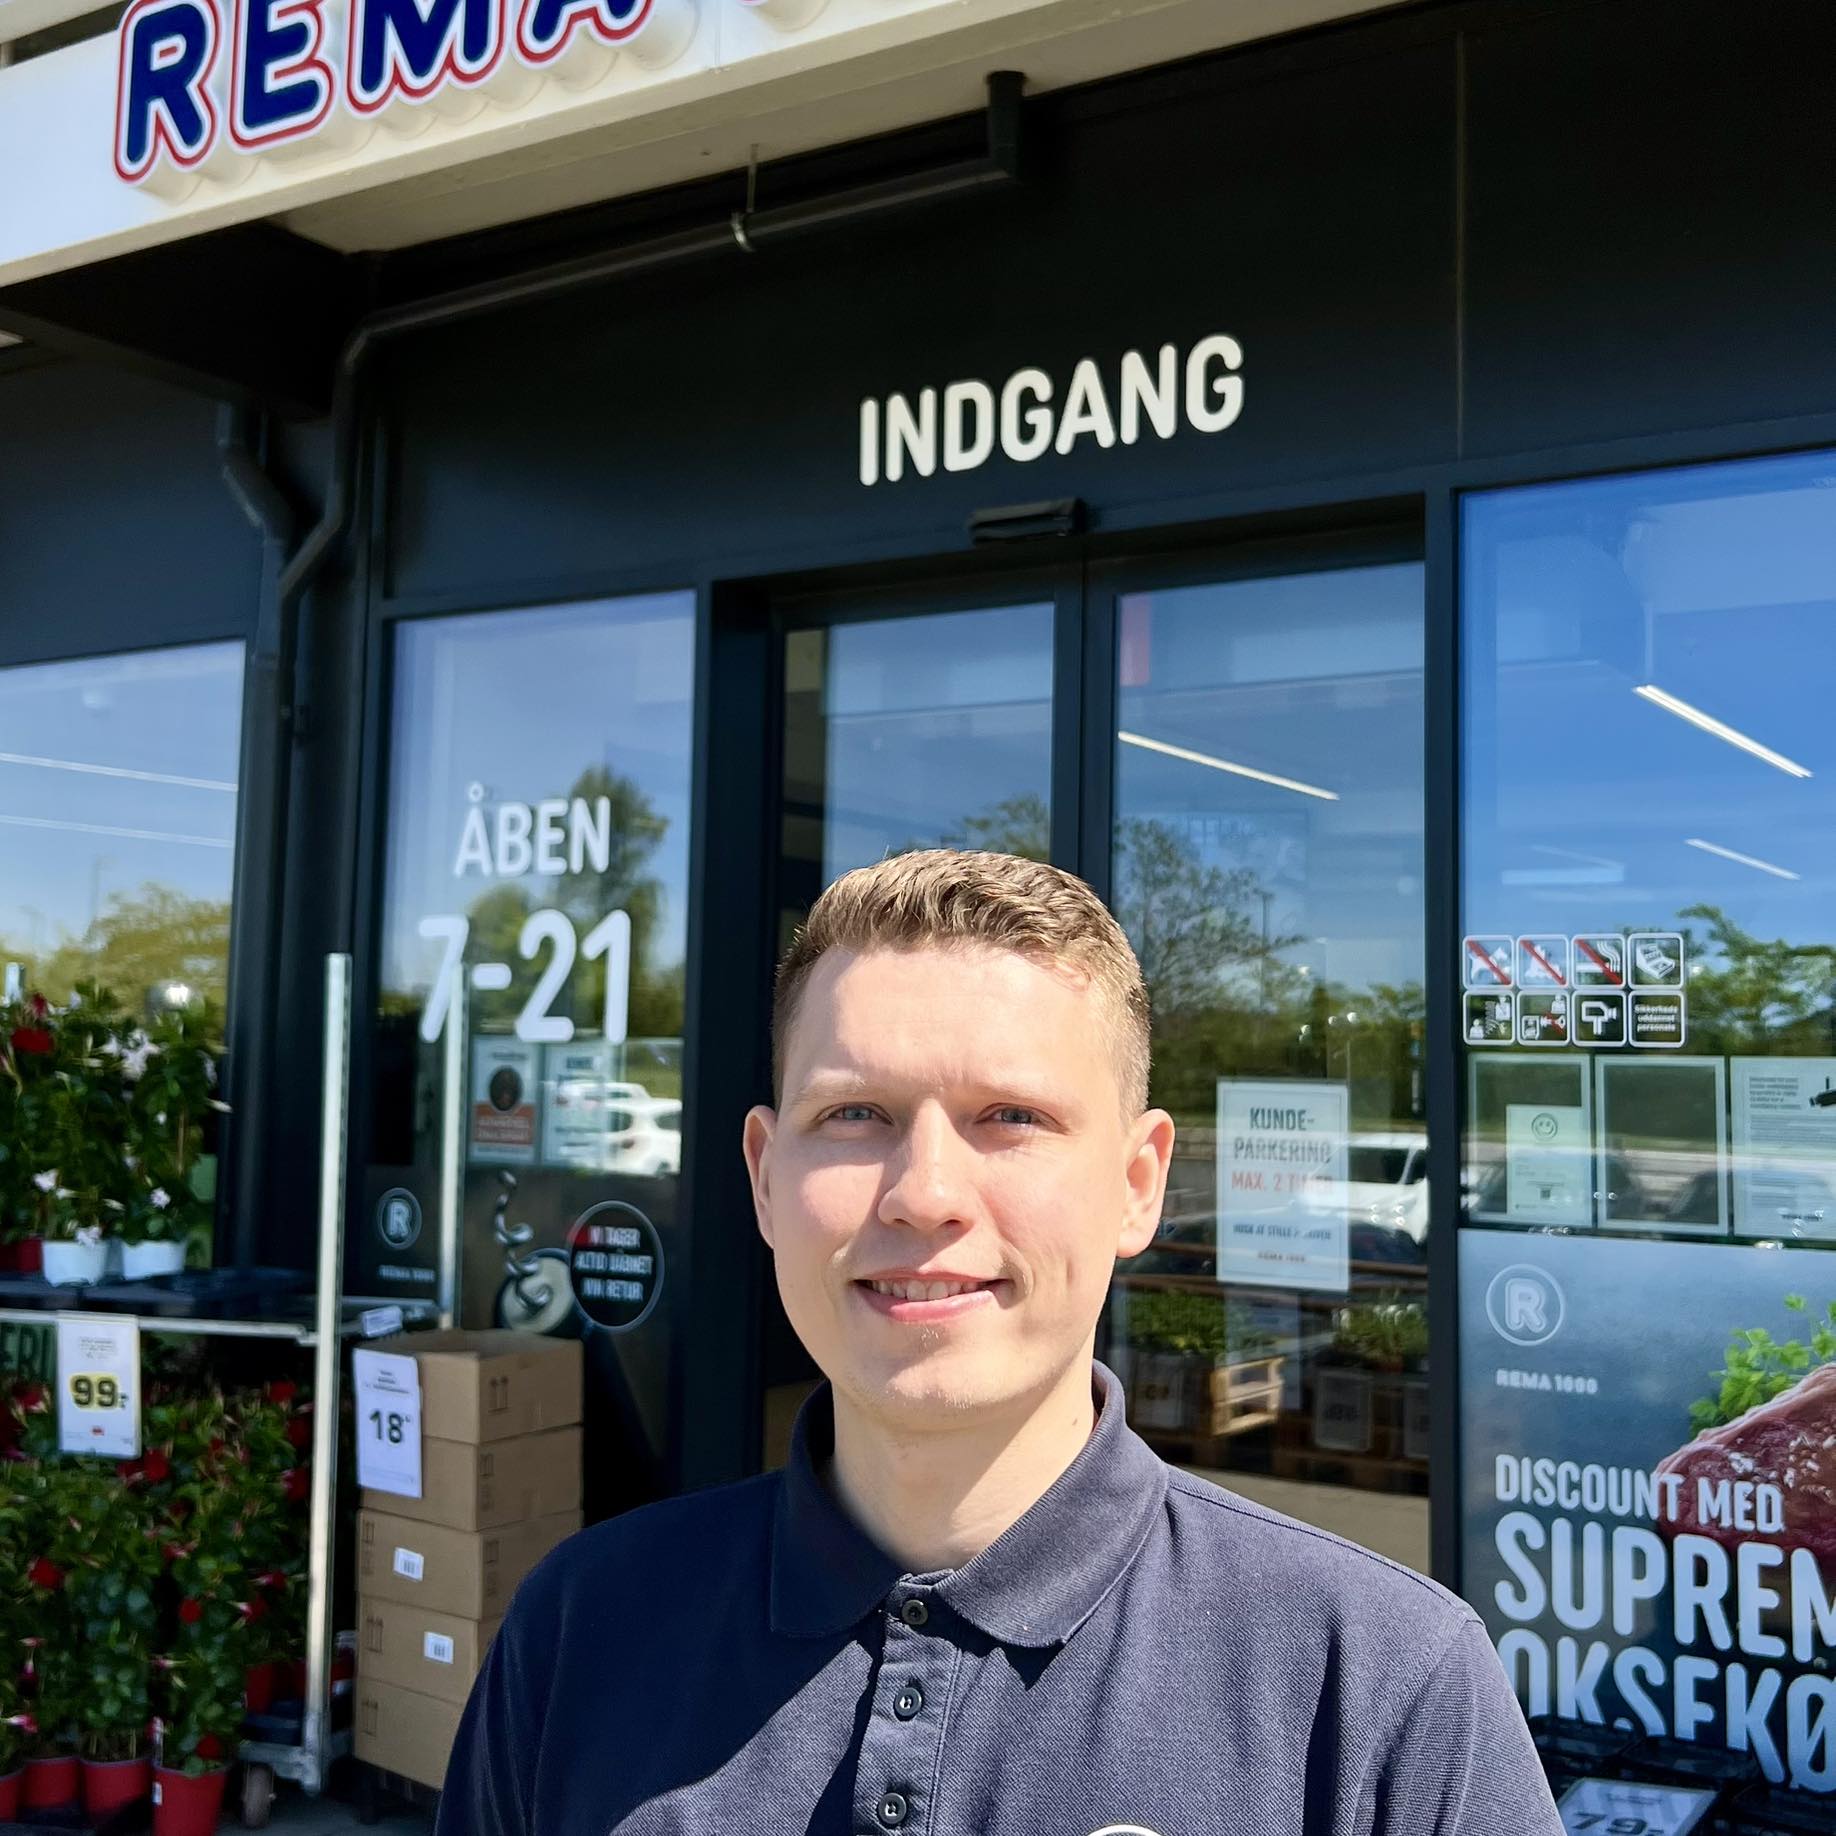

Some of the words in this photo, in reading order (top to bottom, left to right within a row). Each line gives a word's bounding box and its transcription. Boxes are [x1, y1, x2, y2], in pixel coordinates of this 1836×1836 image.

[859, 334, 1244, 486] INDGANG
[453, 781, 612, 878] ÅBEN
[417, 909, 632, 1043] 7-21
[1249, 1106, 1316, 1131] KUNDE-
[1273, 1172, 1282, 1193] 2
[1504, 1277, 1547, 1333] R
[1496, 1368, 1553, 1392] REMA
[1554, 1373, 1599, 1396] 1000
[1495, 1454, 1685, 1521] DISCOUNT
[1698, 1477, 1785, 1533] MED
